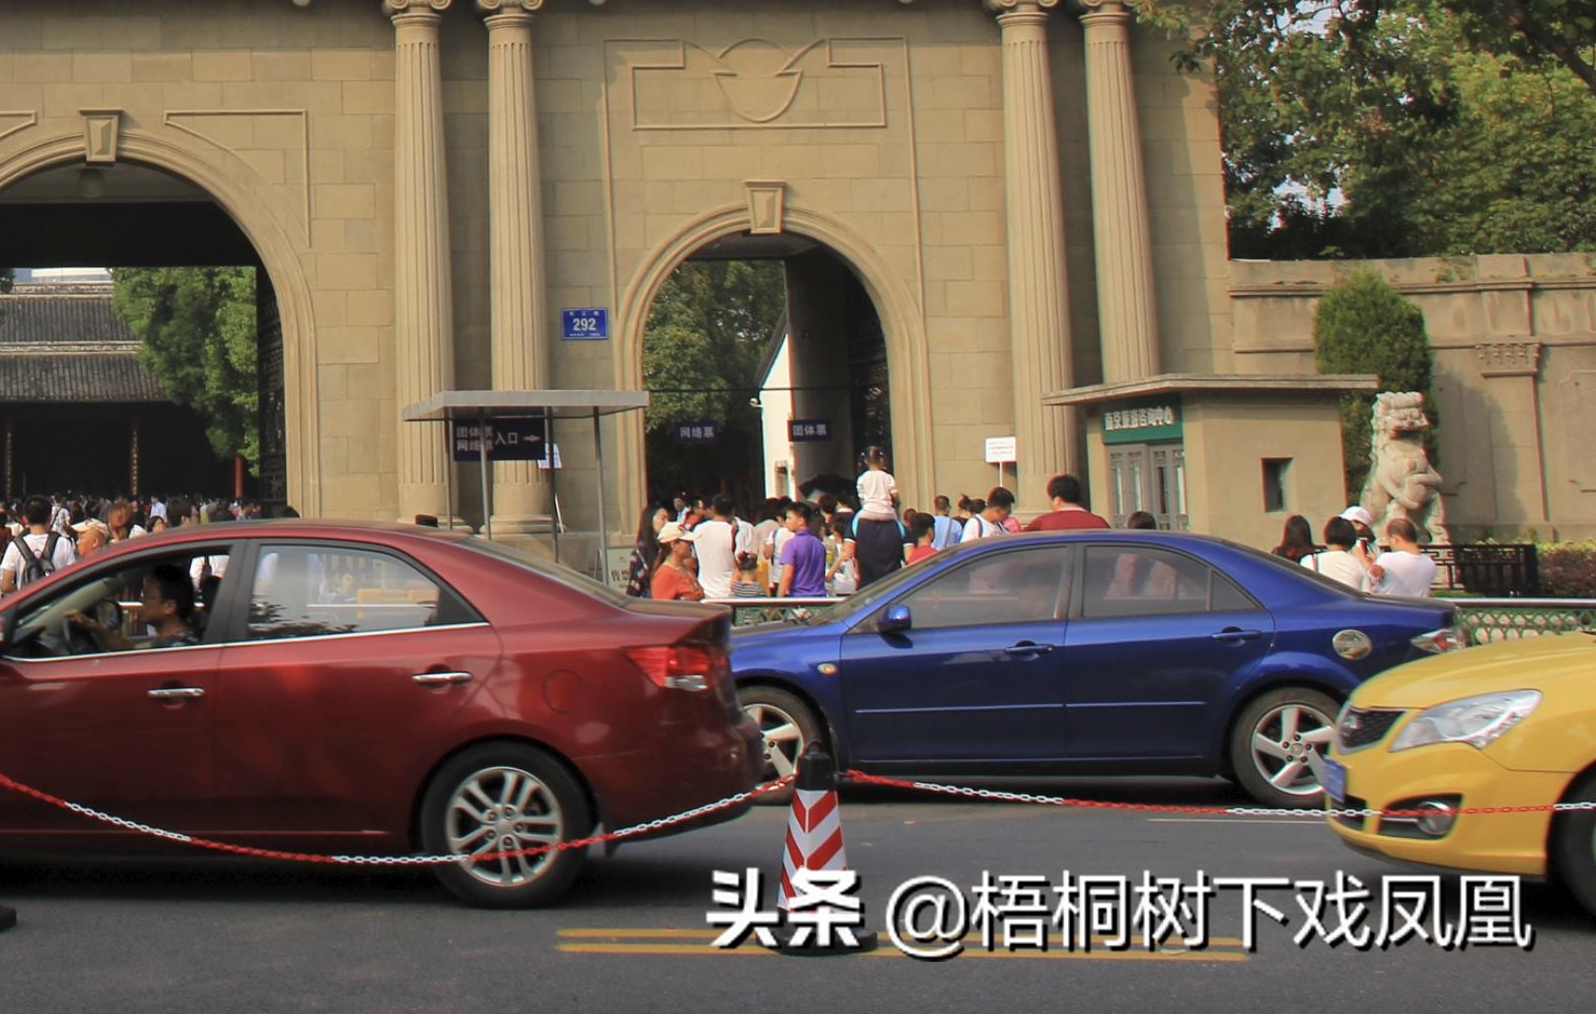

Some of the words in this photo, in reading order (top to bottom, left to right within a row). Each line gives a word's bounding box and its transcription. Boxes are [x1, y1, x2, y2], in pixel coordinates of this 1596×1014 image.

[573, 317, 596, 331] 292
[793, 424, 826, 436] 团体票
[495, 432, 518, 444] 入口
